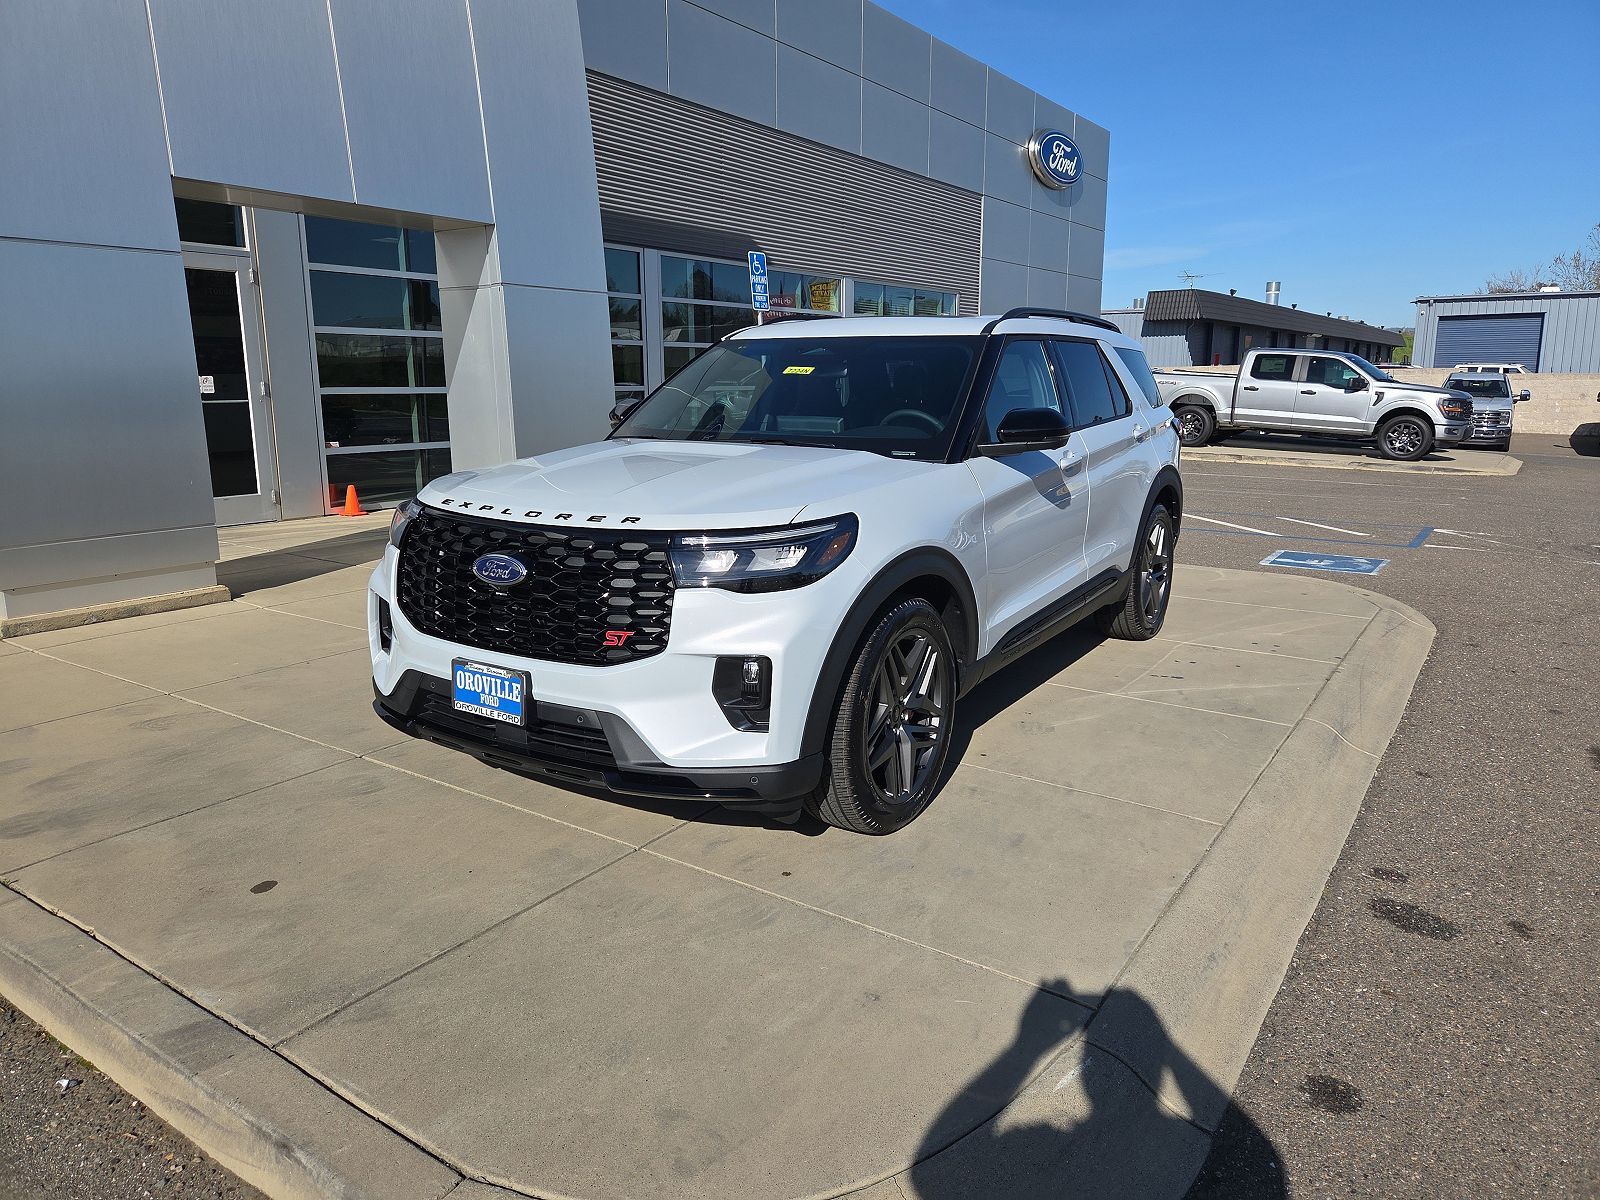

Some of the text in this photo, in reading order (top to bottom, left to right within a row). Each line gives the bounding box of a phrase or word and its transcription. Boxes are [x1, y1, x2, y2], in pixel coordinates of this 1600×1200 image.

[1049, 140, 1078, 177] Ford
[441, 498, 642, 525] EXPLORER
[482, 559, 512, 580] Ford
[602, 630, 635, 647] ST
[456, 670, 521, 703] OROVILLE
[480, 693, 500, 708] FORD
[455, 701, 520, 724] OROVILLE FORD
